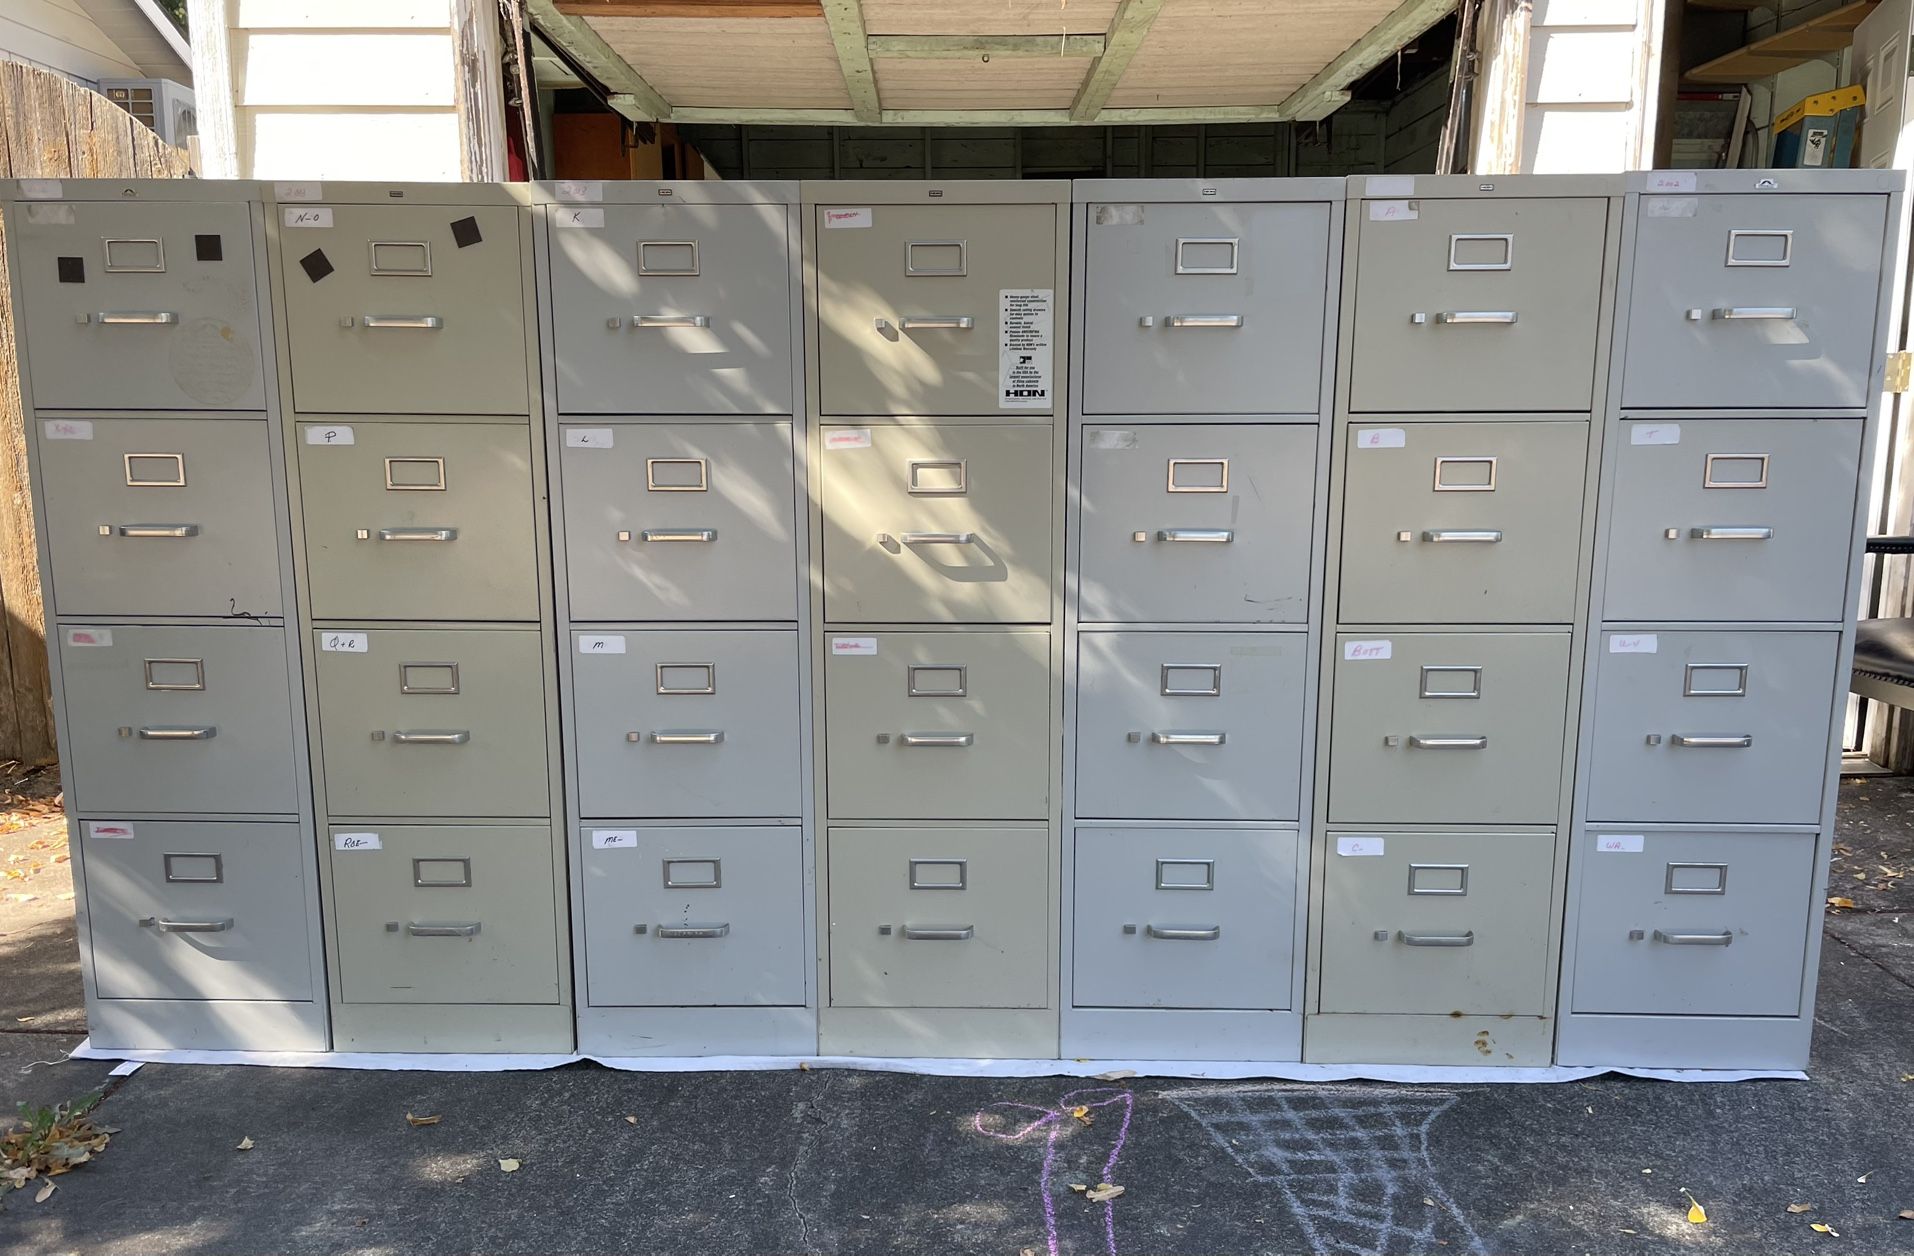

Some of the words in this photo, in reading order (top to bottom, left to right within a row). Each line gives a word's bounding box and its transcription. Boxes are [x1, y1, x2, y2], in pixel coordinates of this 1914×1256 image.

[295, 212, 320, 224] N-O
[572, 211, 581, 223] K
[1005, 389, 1045, 397] HON
[325, 431, 337, 443] P
[330, 635, 340, 651] Q
